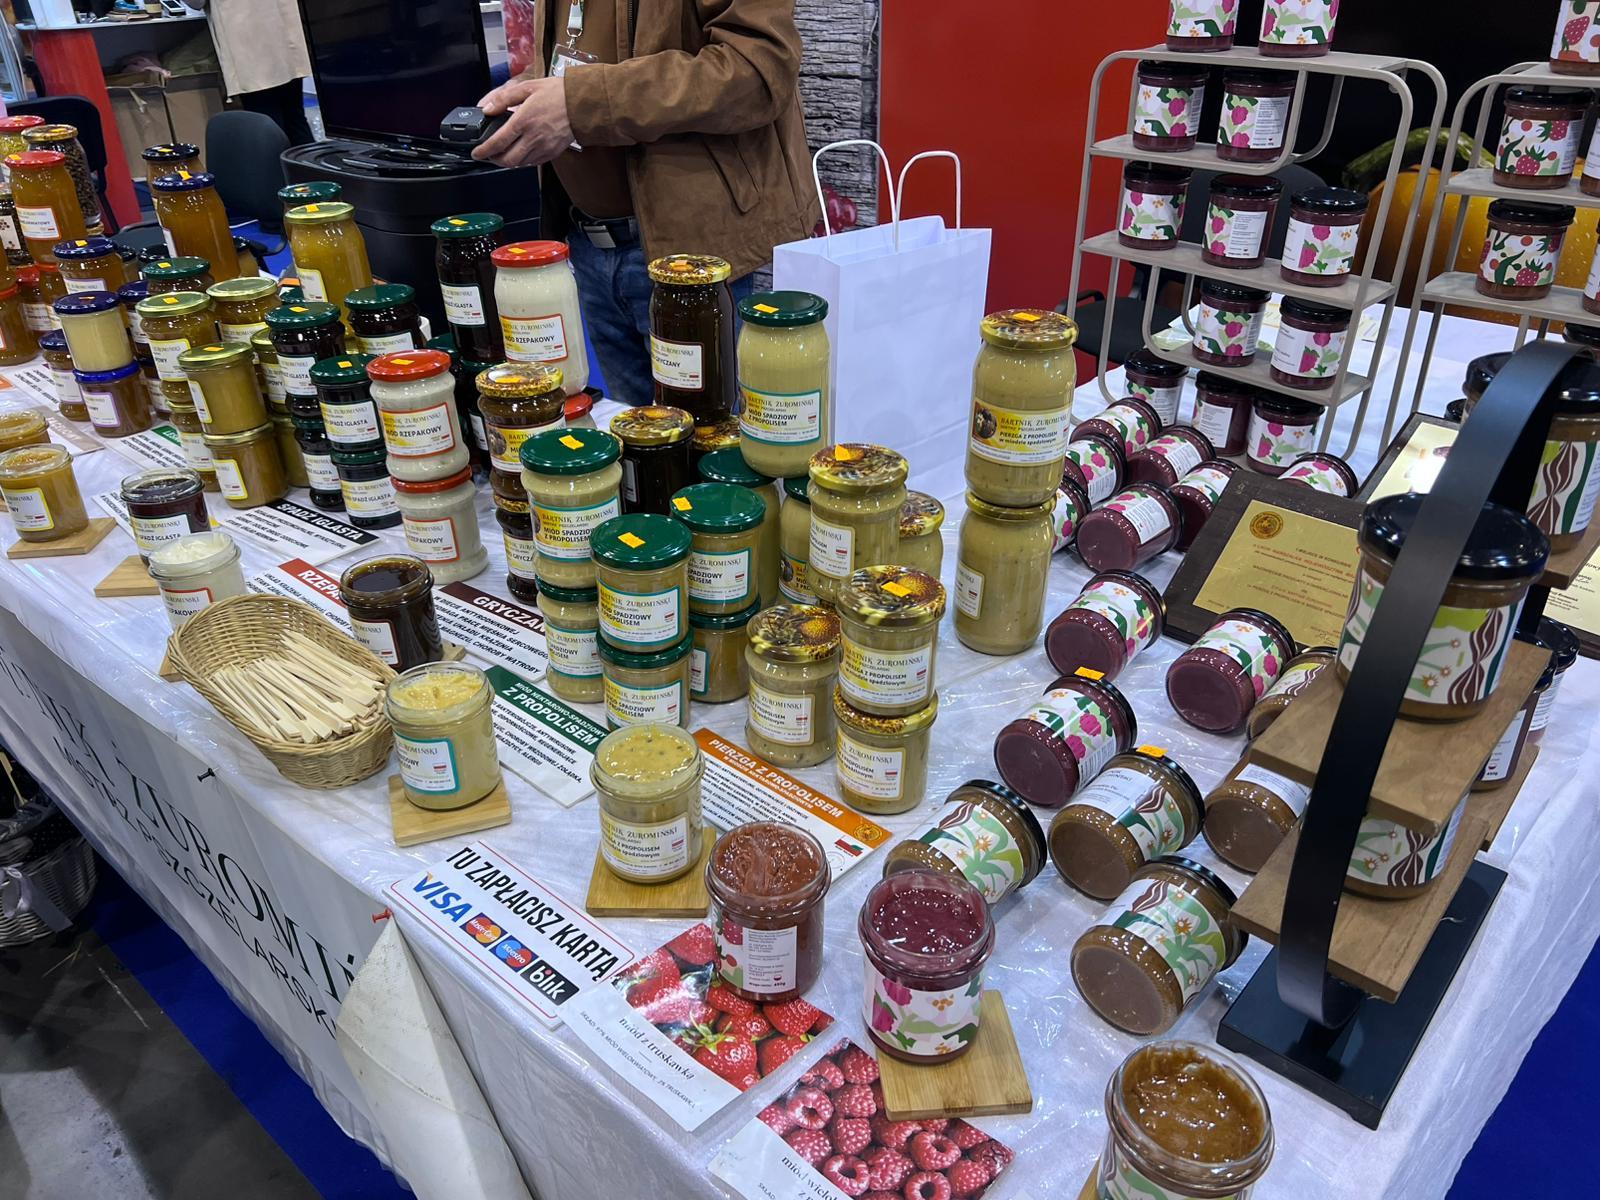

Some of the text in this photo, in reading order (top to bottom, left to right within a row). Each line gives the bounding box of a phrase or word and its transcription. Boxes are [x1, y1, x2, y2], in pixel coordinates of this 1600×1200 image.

[515, 335, 555, 344] RZEPAKOWY
[752, 417, 788, 426] PROPOLISEM
[763, 411, 797, 421] SPADZIOWY
[344, 419, 368, 427] IGLASTA
[399, 424, 443, 438] RZEPAKOWY
[1000, 431, 1022, 440] PIERZGA
[1027, 431, 1058, 440] PROPOLISEM
[367, 492, 392, 502] IGLASTA
[276, 502, 364, 541] SPADŹ IGLASTA
[543, 527, 561, 536] MIÓD
[613, 609, 652, 620] SPADZIOWY
[472, 641, 507, 659] CHOROBY
[869, 671, 907, 680] PROPOLISEM
[617, 702, 656, 714] SPADZIOWY
[501, 686, 600, 746] Z PROPOLISEM
[709, 738, 757, 768] PIERZGA
[755, 765, 769, 775] Z
[765, 770, 844, 819] PROPOLISEM
[621, 843, 660, 852] PROPOLISEM
[412, 871, 473, 923] VISA
[446, 846, 619, 982] TU ZAPŁACISZ KARTĄ
[468, 917, 499, 941] MasterCard
[529, 963, 567, 1001] blik
[647, 1041, 696, 1081] truskawką
